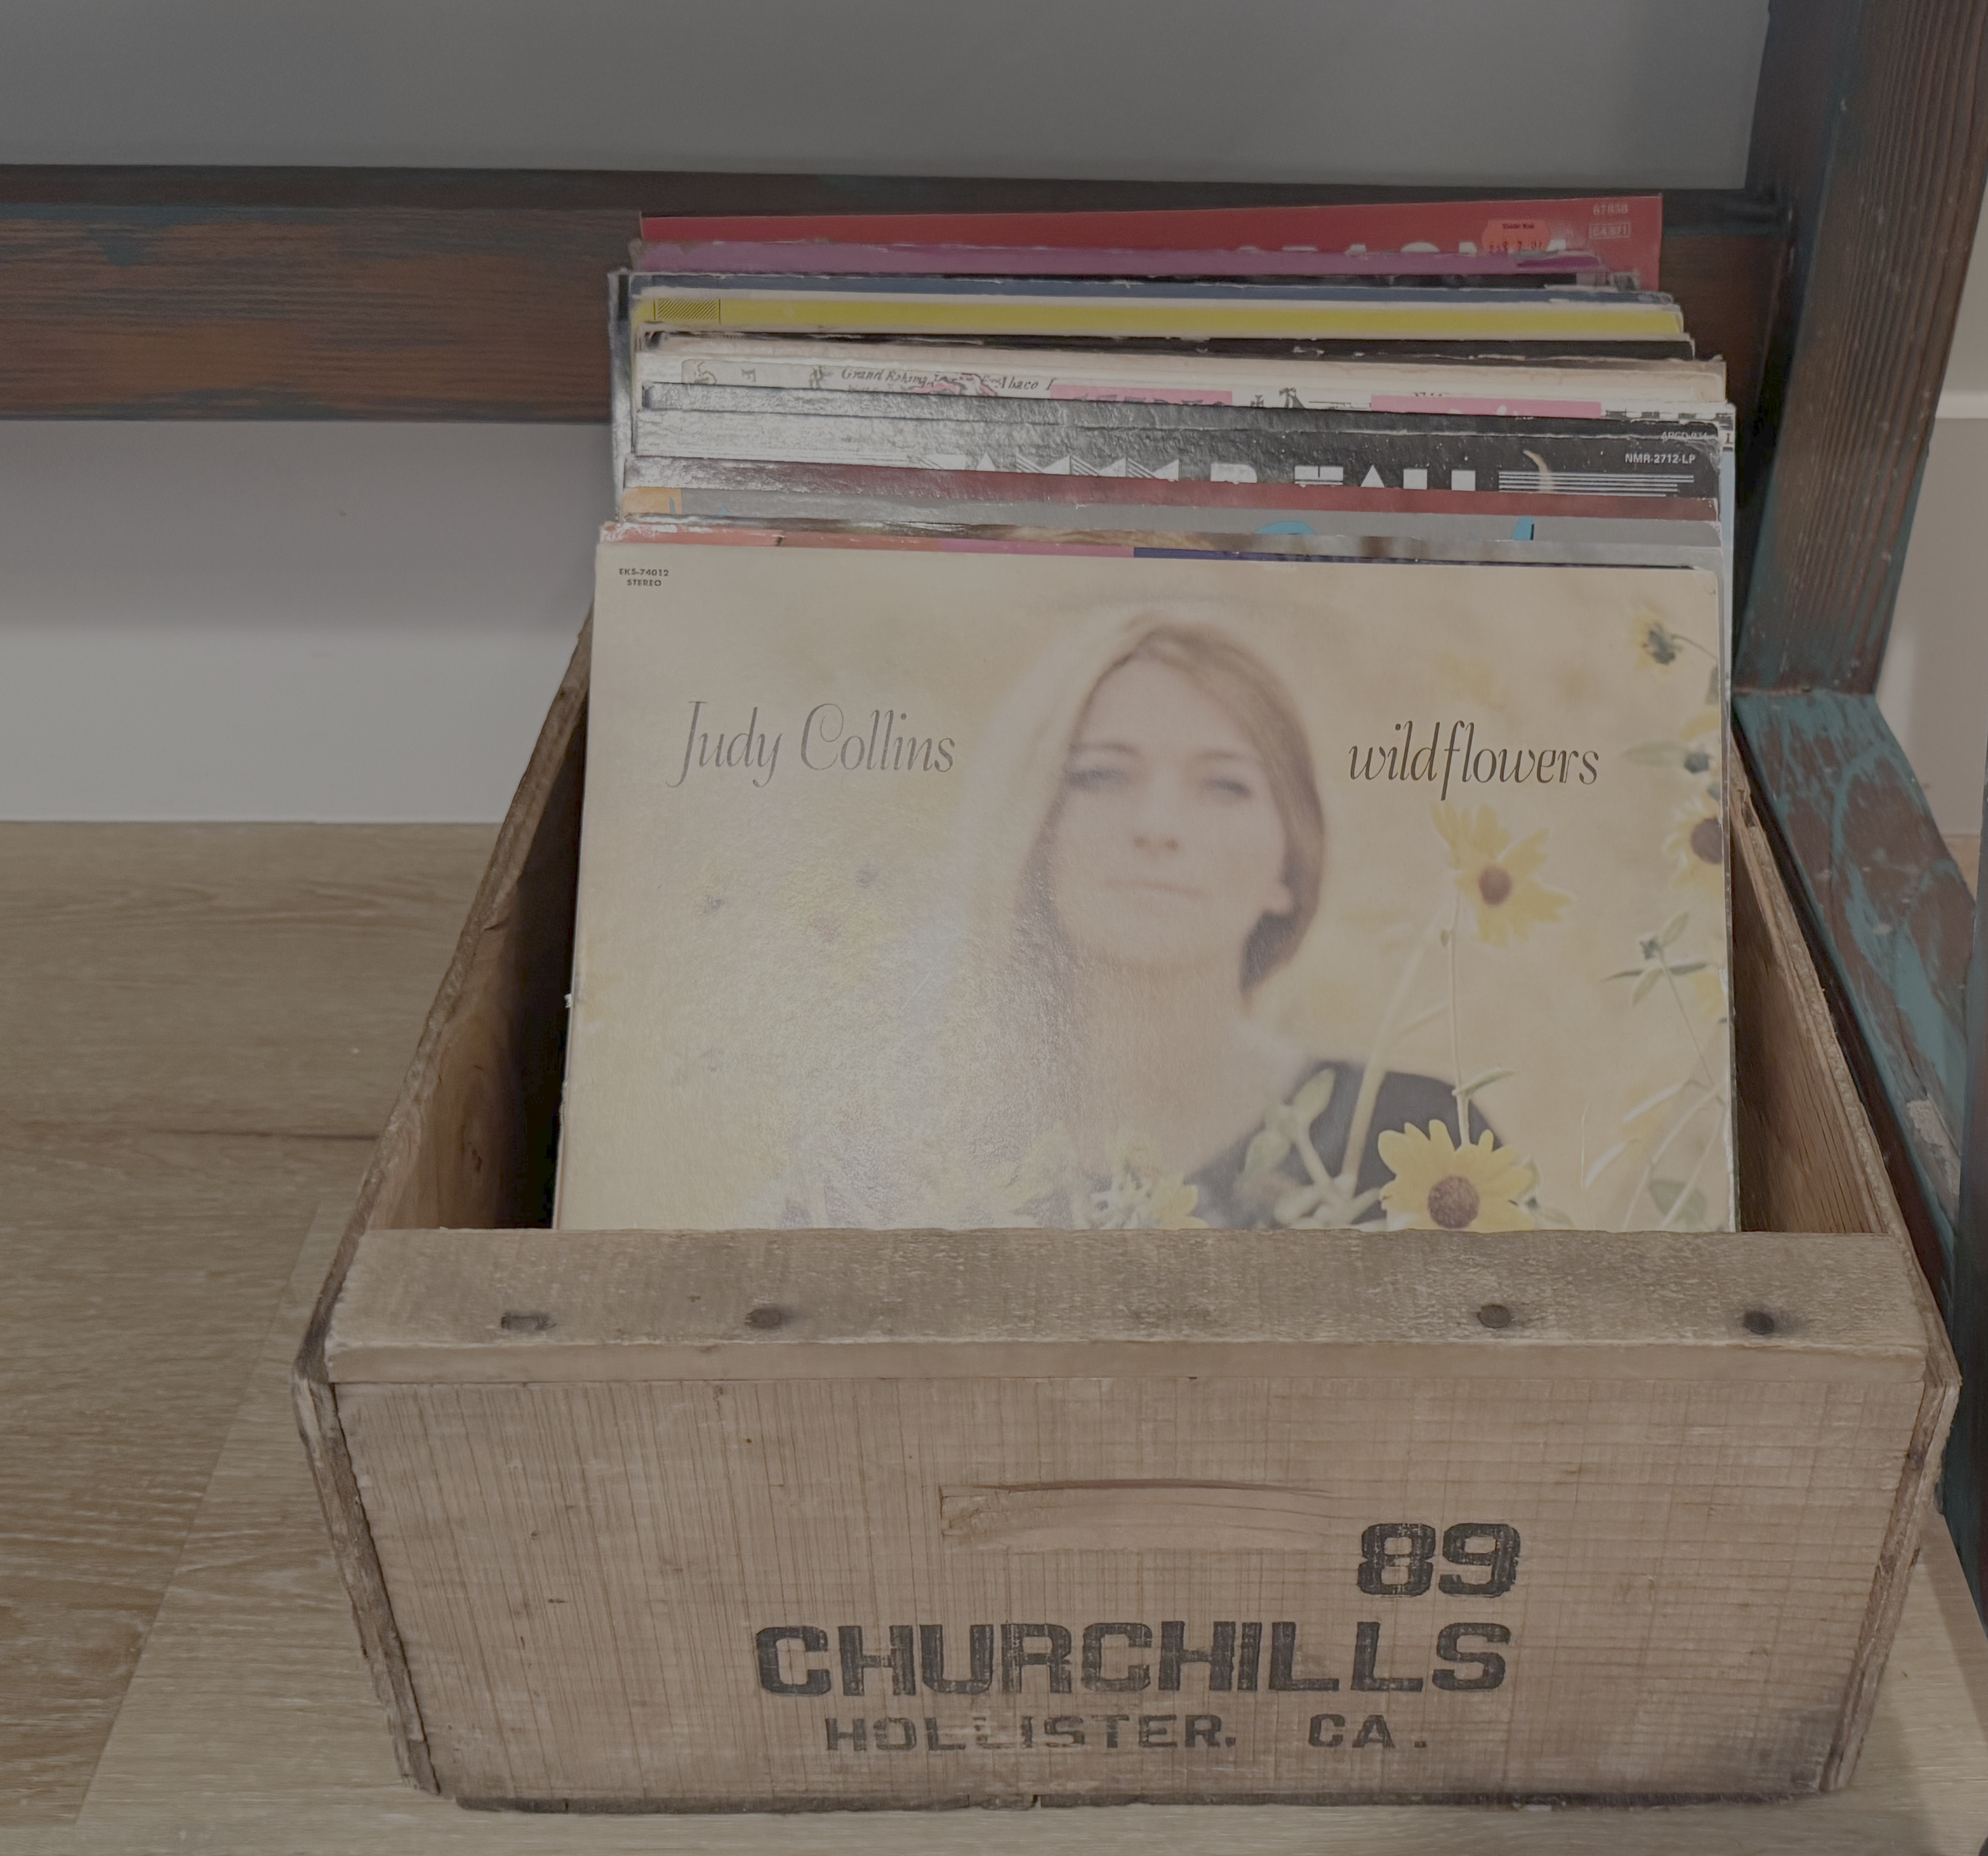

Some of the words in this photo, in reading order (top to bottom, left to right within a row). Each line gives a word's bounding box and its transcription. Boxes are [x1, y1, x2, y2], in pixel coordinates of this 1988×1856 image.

[842, 368, 885, 380] Grand
[619, 568, 669, 577] EKS-74012
[627, 578, 662, 587] STEREO
[666, 701, 783, 788] Judy
[800, 704, 955, 772] Collins
[1349, 721, 1599, 801] wildflowers
[1357, 1522, 1521, 1598] 89
[755, 1620, 1511, 1697] CHURCHILLS
